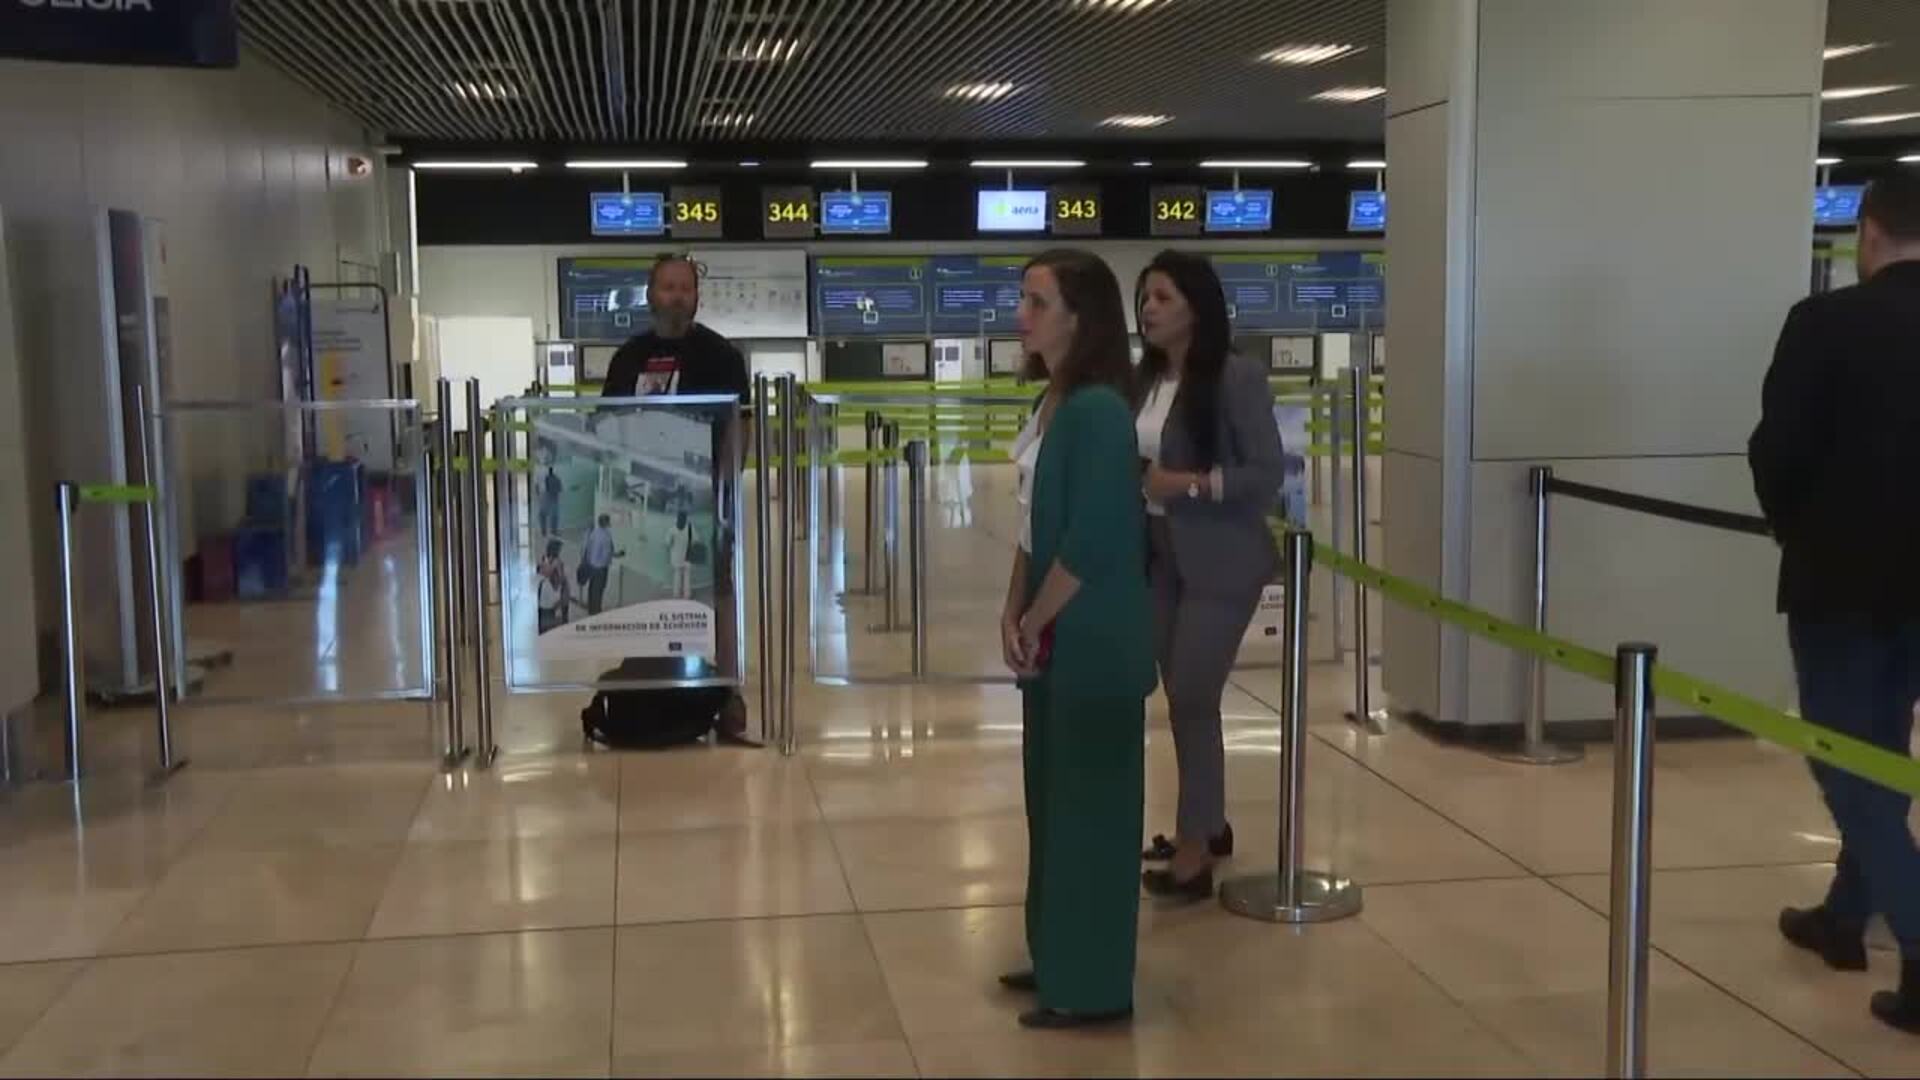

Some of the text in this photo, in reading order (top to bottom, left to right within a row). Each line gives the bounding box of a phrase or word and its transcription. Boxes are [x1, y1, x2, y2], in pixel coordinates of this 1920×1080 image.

[676, 203, 718, 221] 345
[768, 202, 809, 222] 344
[1057, 200, 1096, 218] 343
[1157, 201, 1195, 220] 342
[659, 611, 707, 621] EL SISTEMA
[649, 622, 660, 631] DE
